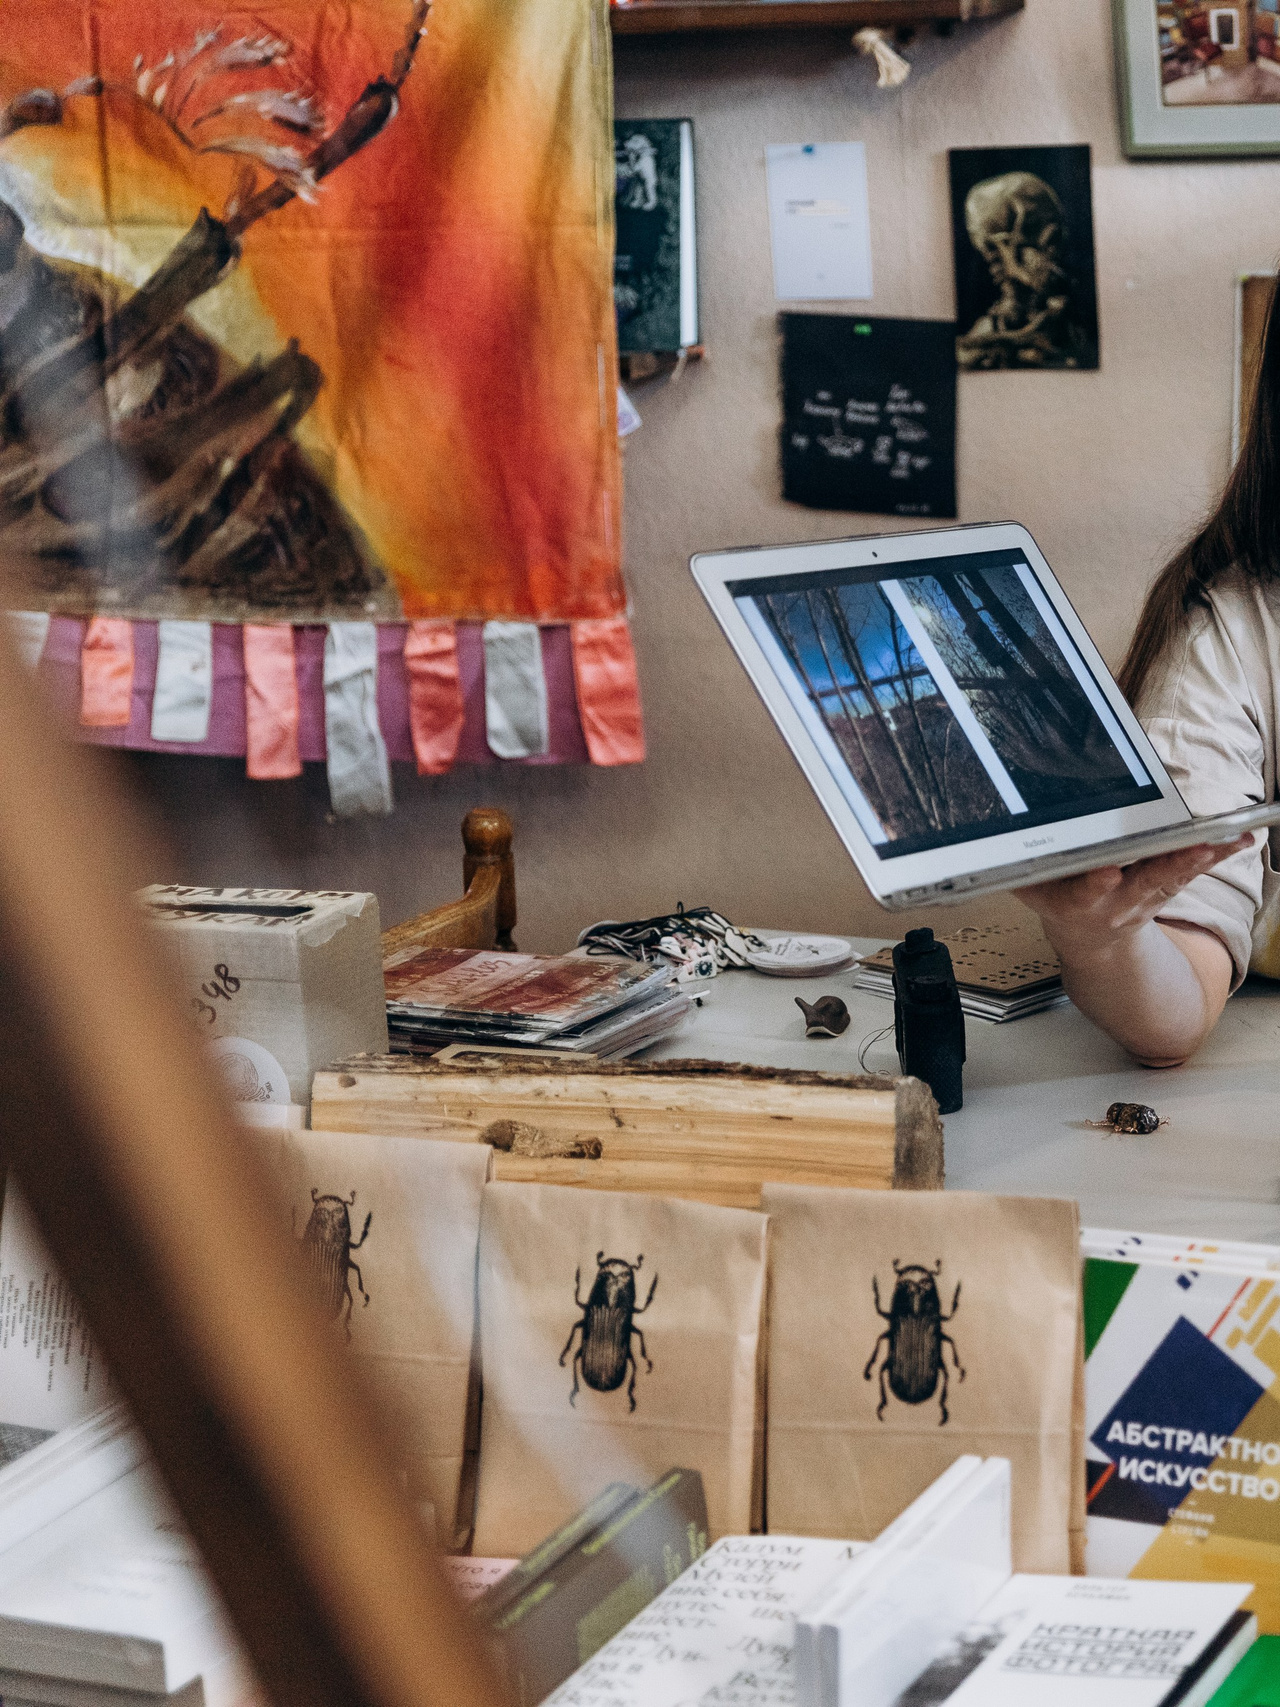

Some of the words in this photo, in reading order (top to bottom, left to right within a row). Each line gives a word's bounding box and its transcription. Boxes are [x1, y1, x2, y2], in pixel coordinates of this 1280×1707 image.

[715, 1540, 804, 1558] Калум
[699, 1556, 804, 1573] Сторри
[688, 1569, 776, 1584] Музей
[1029, 1621, 1198, 1642] КРАТКАЯ
[1018, 1639, 1189, 1658] ИСТОРИЯ
